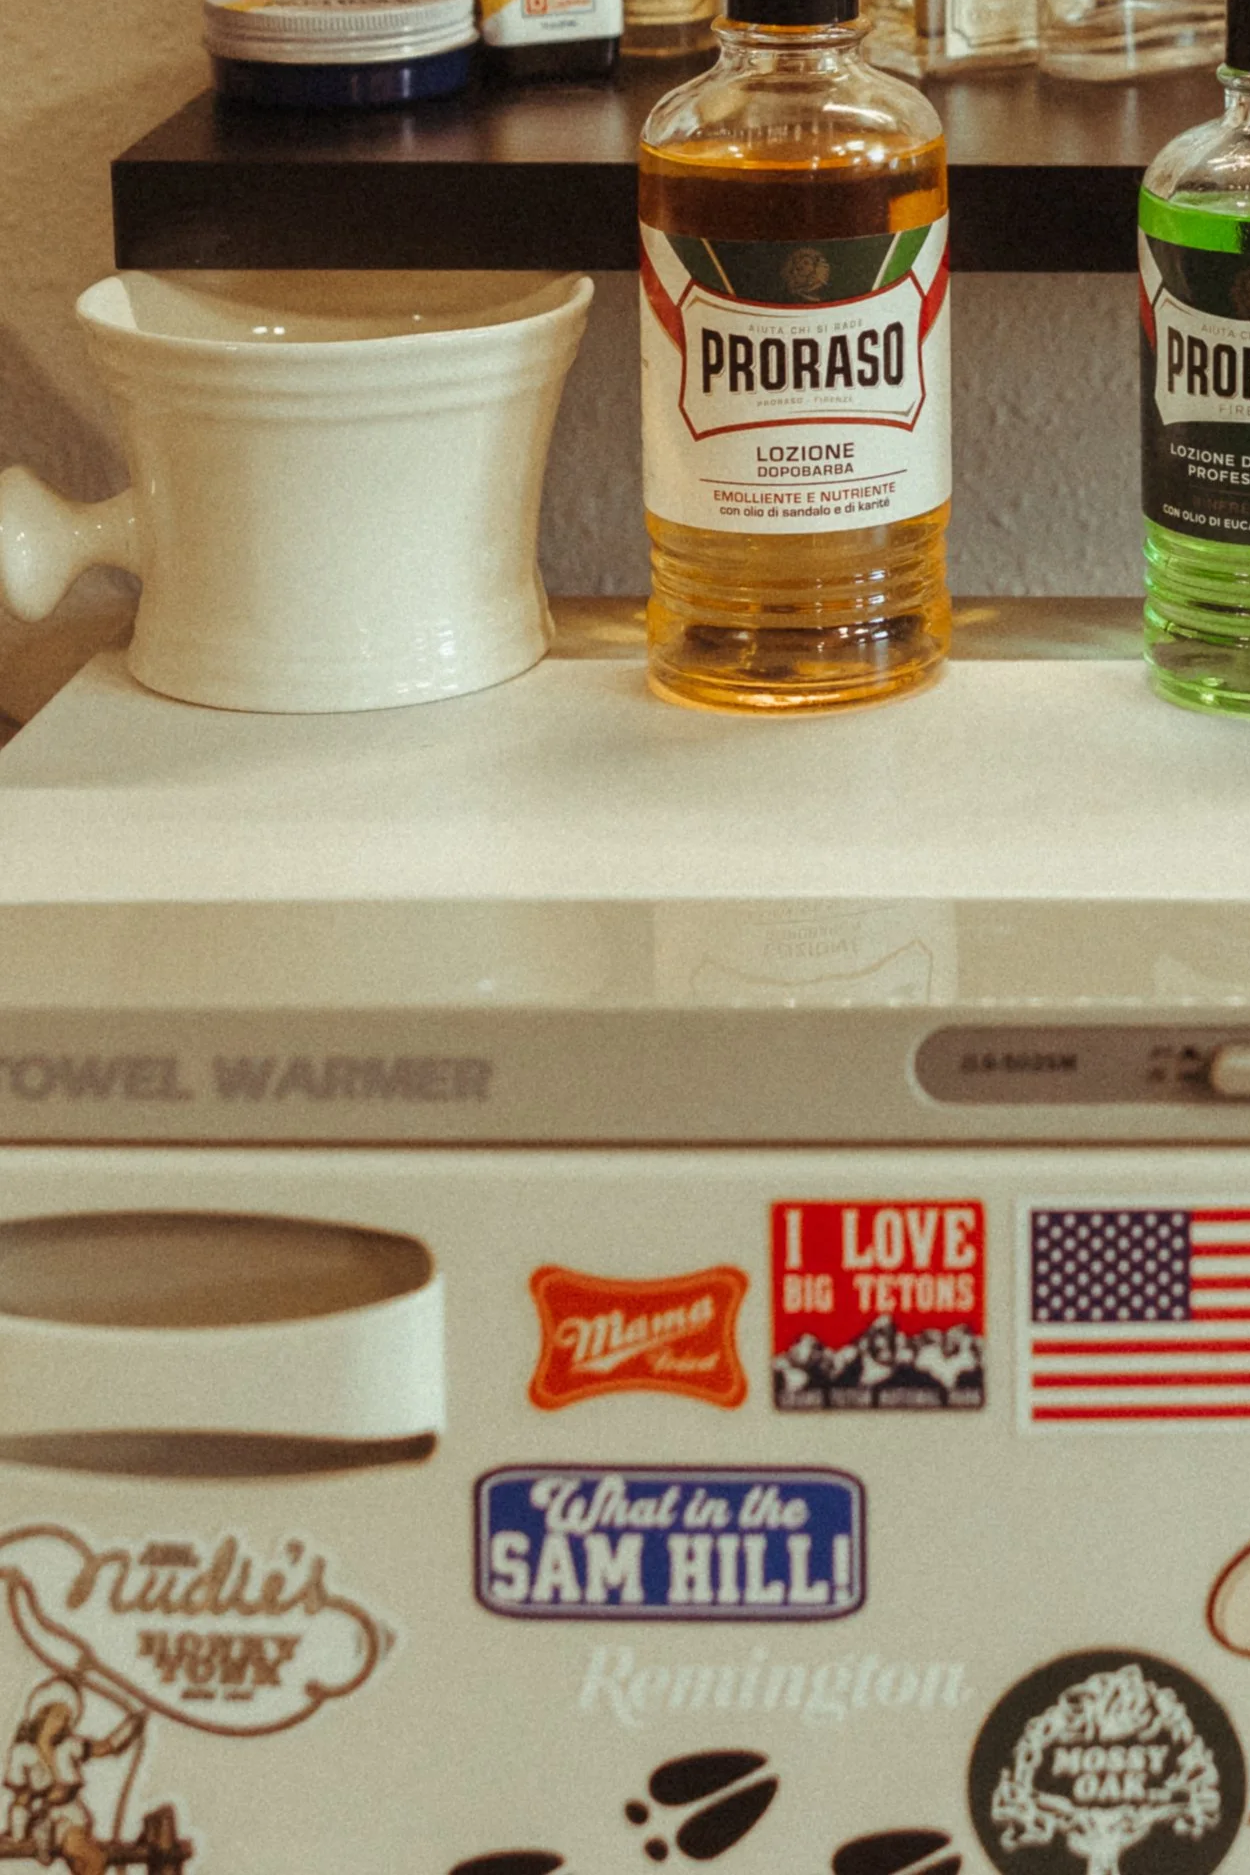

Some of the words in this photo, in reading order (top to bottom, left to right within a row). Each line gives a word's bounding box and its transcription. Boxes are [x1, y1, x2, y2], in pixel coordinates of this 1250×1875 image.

[749, 323, 784, 336] AIUTA
[790, 326, 811, 335] CHI
[817, 323, 828, 334] SI
[1201, 323, 1235, 338] AIUTA
[702, 321, 904, 394] PRORASO
[756, 397, 804, 407] PRORASO
[814, 395, 853, 405] FIRENZE
[756, 442, 855, 462] LOZIONE
[1170, 443, 1235, 467] LOZIONE
[757, 462, 854, 478] DOPOBARBA
[713, 489, 801, 504] EMOLLIENTE
[807, 493, 815, 503] E
[820, 482, 896, 502] NUTRIENTE
[719, 505, 740, 516] con
[744, 505, 763, 517] olio
[767, 505, 778, 517] di
[783, 504, 831, 517] sandalo
[834, 505, 841, 514] e
[845, 501, 855, 513] di
[1163, 503, 1180, 519] CON
[1183, 510, 1206, 525] OLIO
[1209, 516, 1220, 527] DI
[211, 1054, 494, 1103] WARMER
[784, 1208, 803, 1270] I
[841, 1207, 976, 1271] LOVE
[783, 1273, 833, 1314] BIG
[853, 1272, 976, 1313] TETONS
[554, 1295, 714, 1366] Mama
[529, 1476, 681, 1534] What
[684, 1486, 731, 1528] in
[738, 1485, 810, 1529] the
[490, 1530, 644, 1605] SAM
[666, 1531, 851, 1606] HILL!
[578, 1644, 968, 1728] Remington
[1052, 1745, 1169, 1777] MOSSY
[1073, 1771, 1148, 1802] OAK
